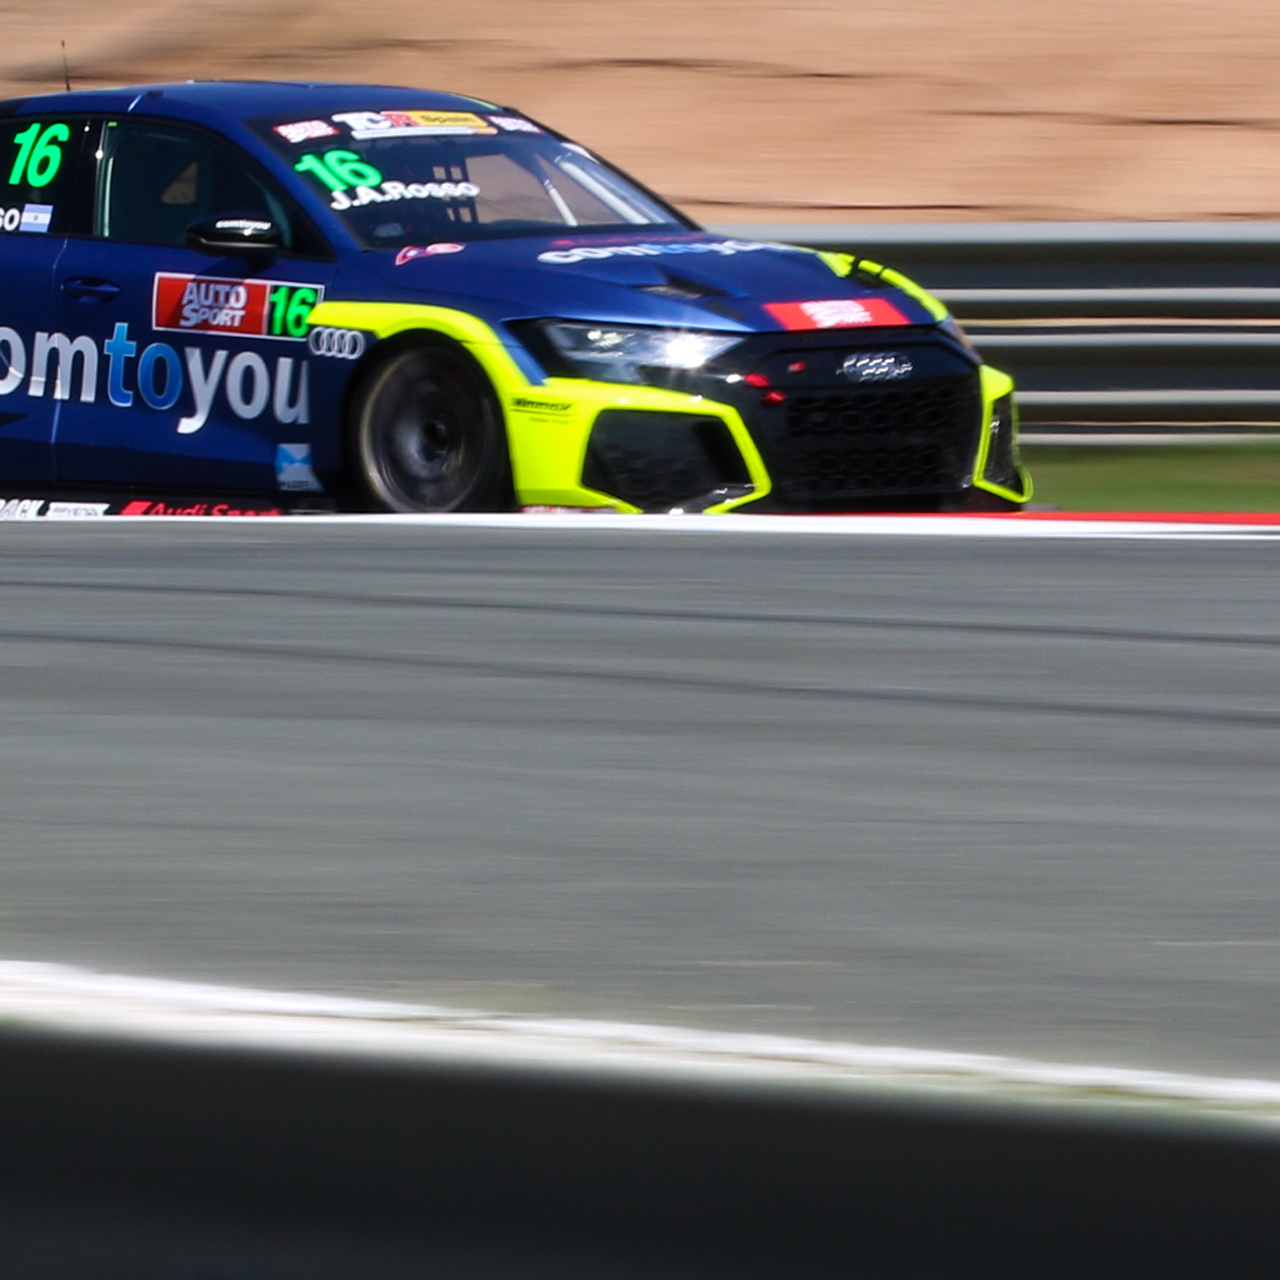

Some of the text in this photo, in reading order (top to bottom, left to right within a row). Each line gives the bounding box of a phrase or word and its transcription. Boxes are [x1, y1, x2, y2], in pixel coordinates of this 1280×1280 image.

[8, 123, 70, 188] 16
[294, 149, 383, 192] 16
[330, 180, 480, 210] J.A.Rosso
[181, 282, 248, 308] AUTO
[270, 286, 317, 338] 16
[179, 305, 246, 328] SPORT
